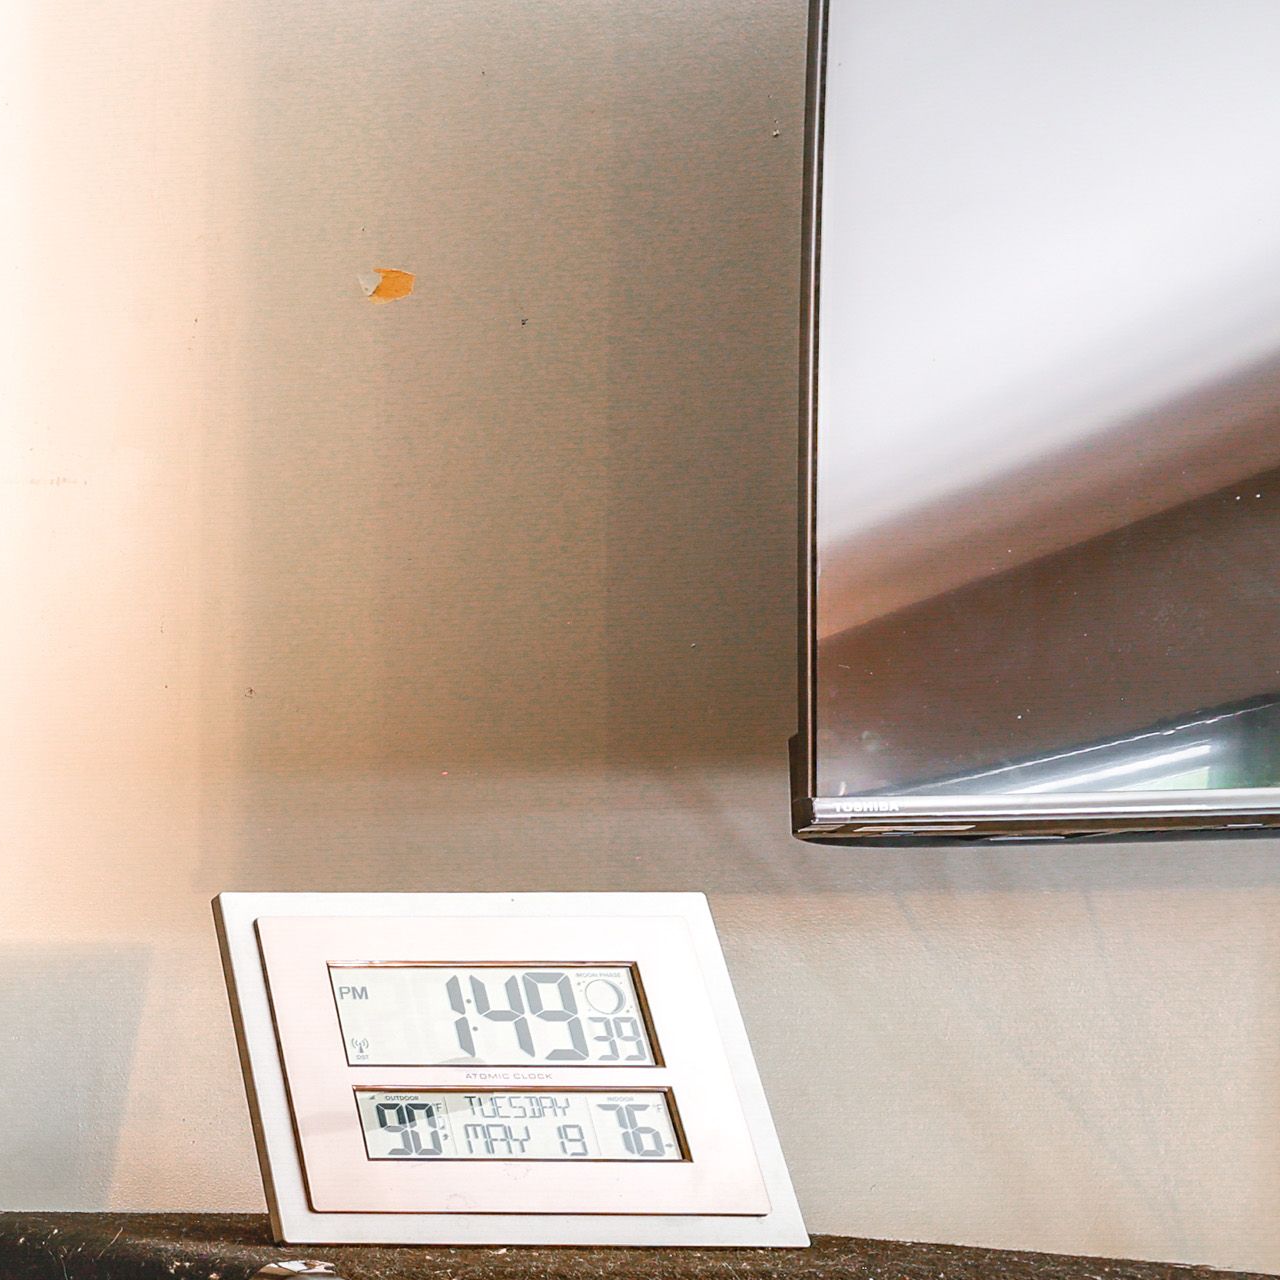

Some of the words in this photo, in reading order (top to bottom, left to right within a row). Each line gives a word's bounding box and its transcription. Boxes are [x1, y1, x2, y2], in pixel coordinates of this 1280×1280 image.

[832, 802, 900, 812] TOSHIBA
[338, 986, 369, 1000] PM
[588, 1016, 648, 1061] 39
[464, 1095, 571, 1119] TUESDAY
[376, 1103, 443, 1156] 90
[464, 1123, 531, 1155] MAY
[557, 1124, 589, 1157] 19
[596, 1103, 666, 1157] 76
